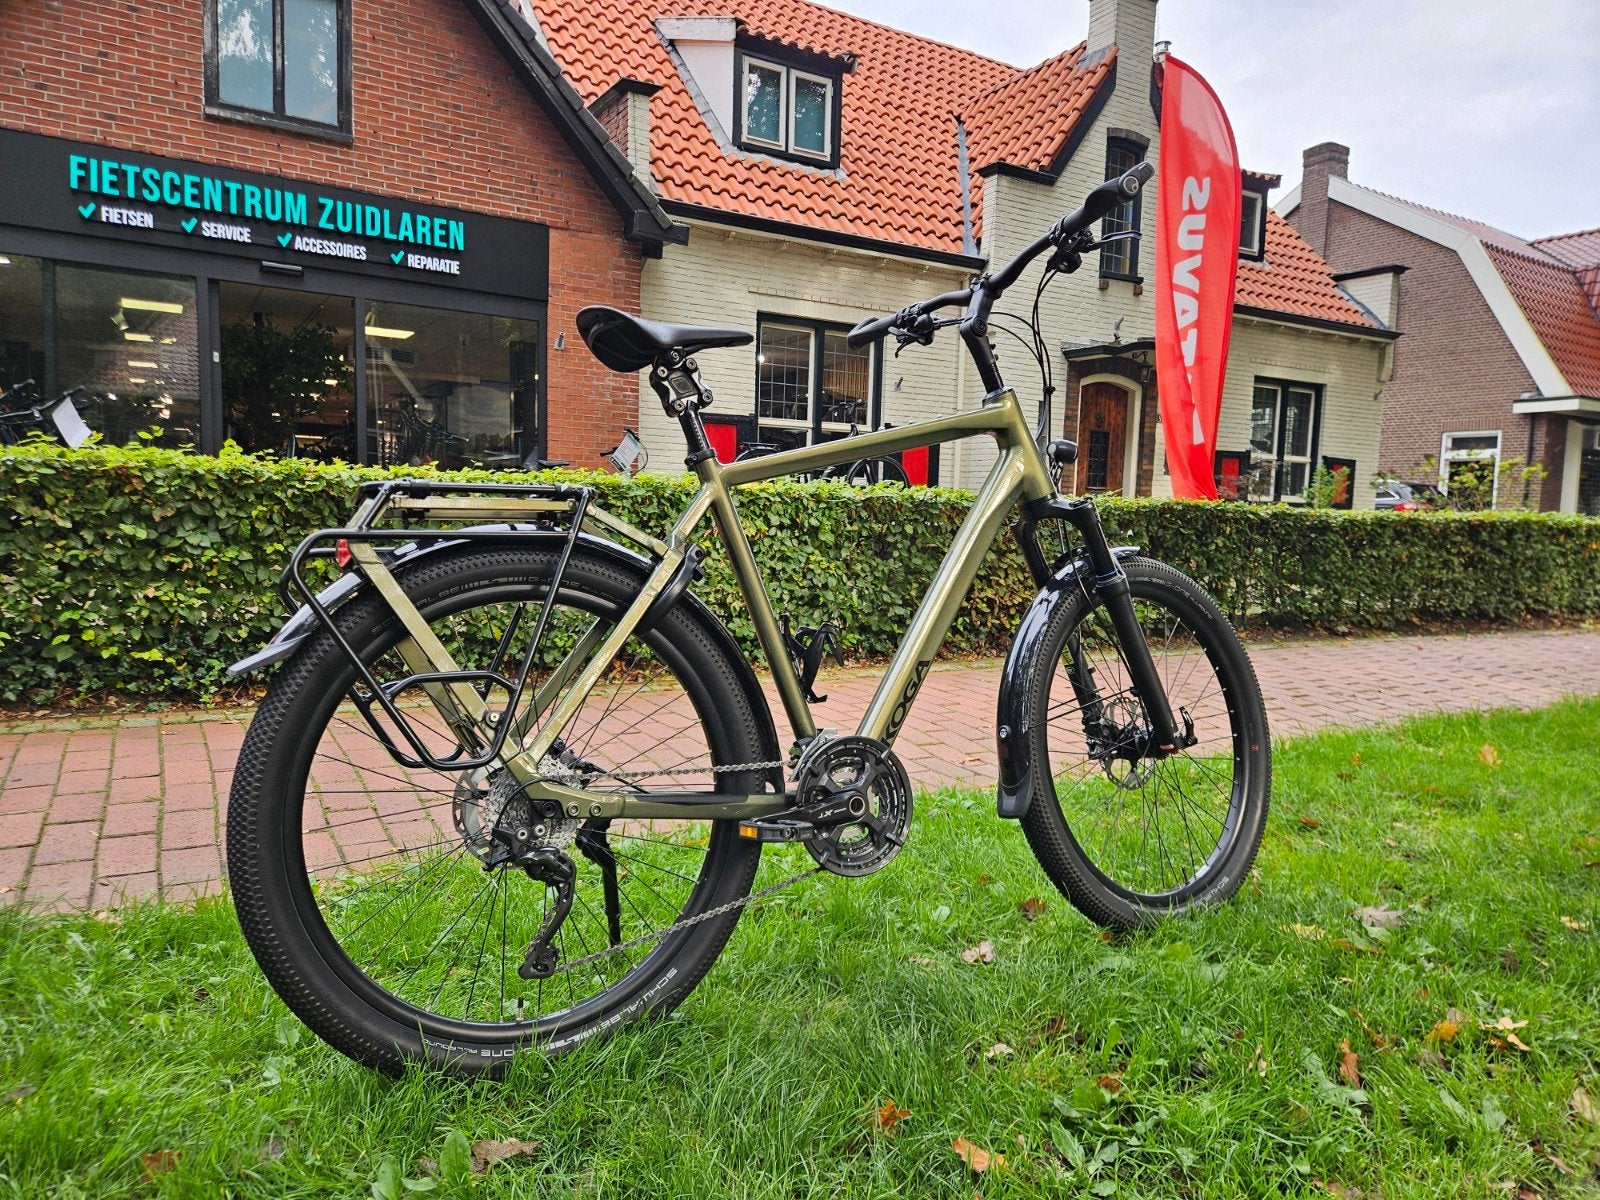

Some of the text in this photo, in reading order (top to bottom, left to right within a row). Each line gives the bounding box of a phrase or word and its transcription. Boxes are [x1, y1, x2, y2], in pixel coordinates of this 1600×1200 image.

[69, 154, 465, 251] FIETSCENTRUM ZUIDLAREN
[101, 205, 461, 275] FIETSEN SERVICE ACCESSOIRES REPARATIE
[880, 660, 931, 747] KOGA
